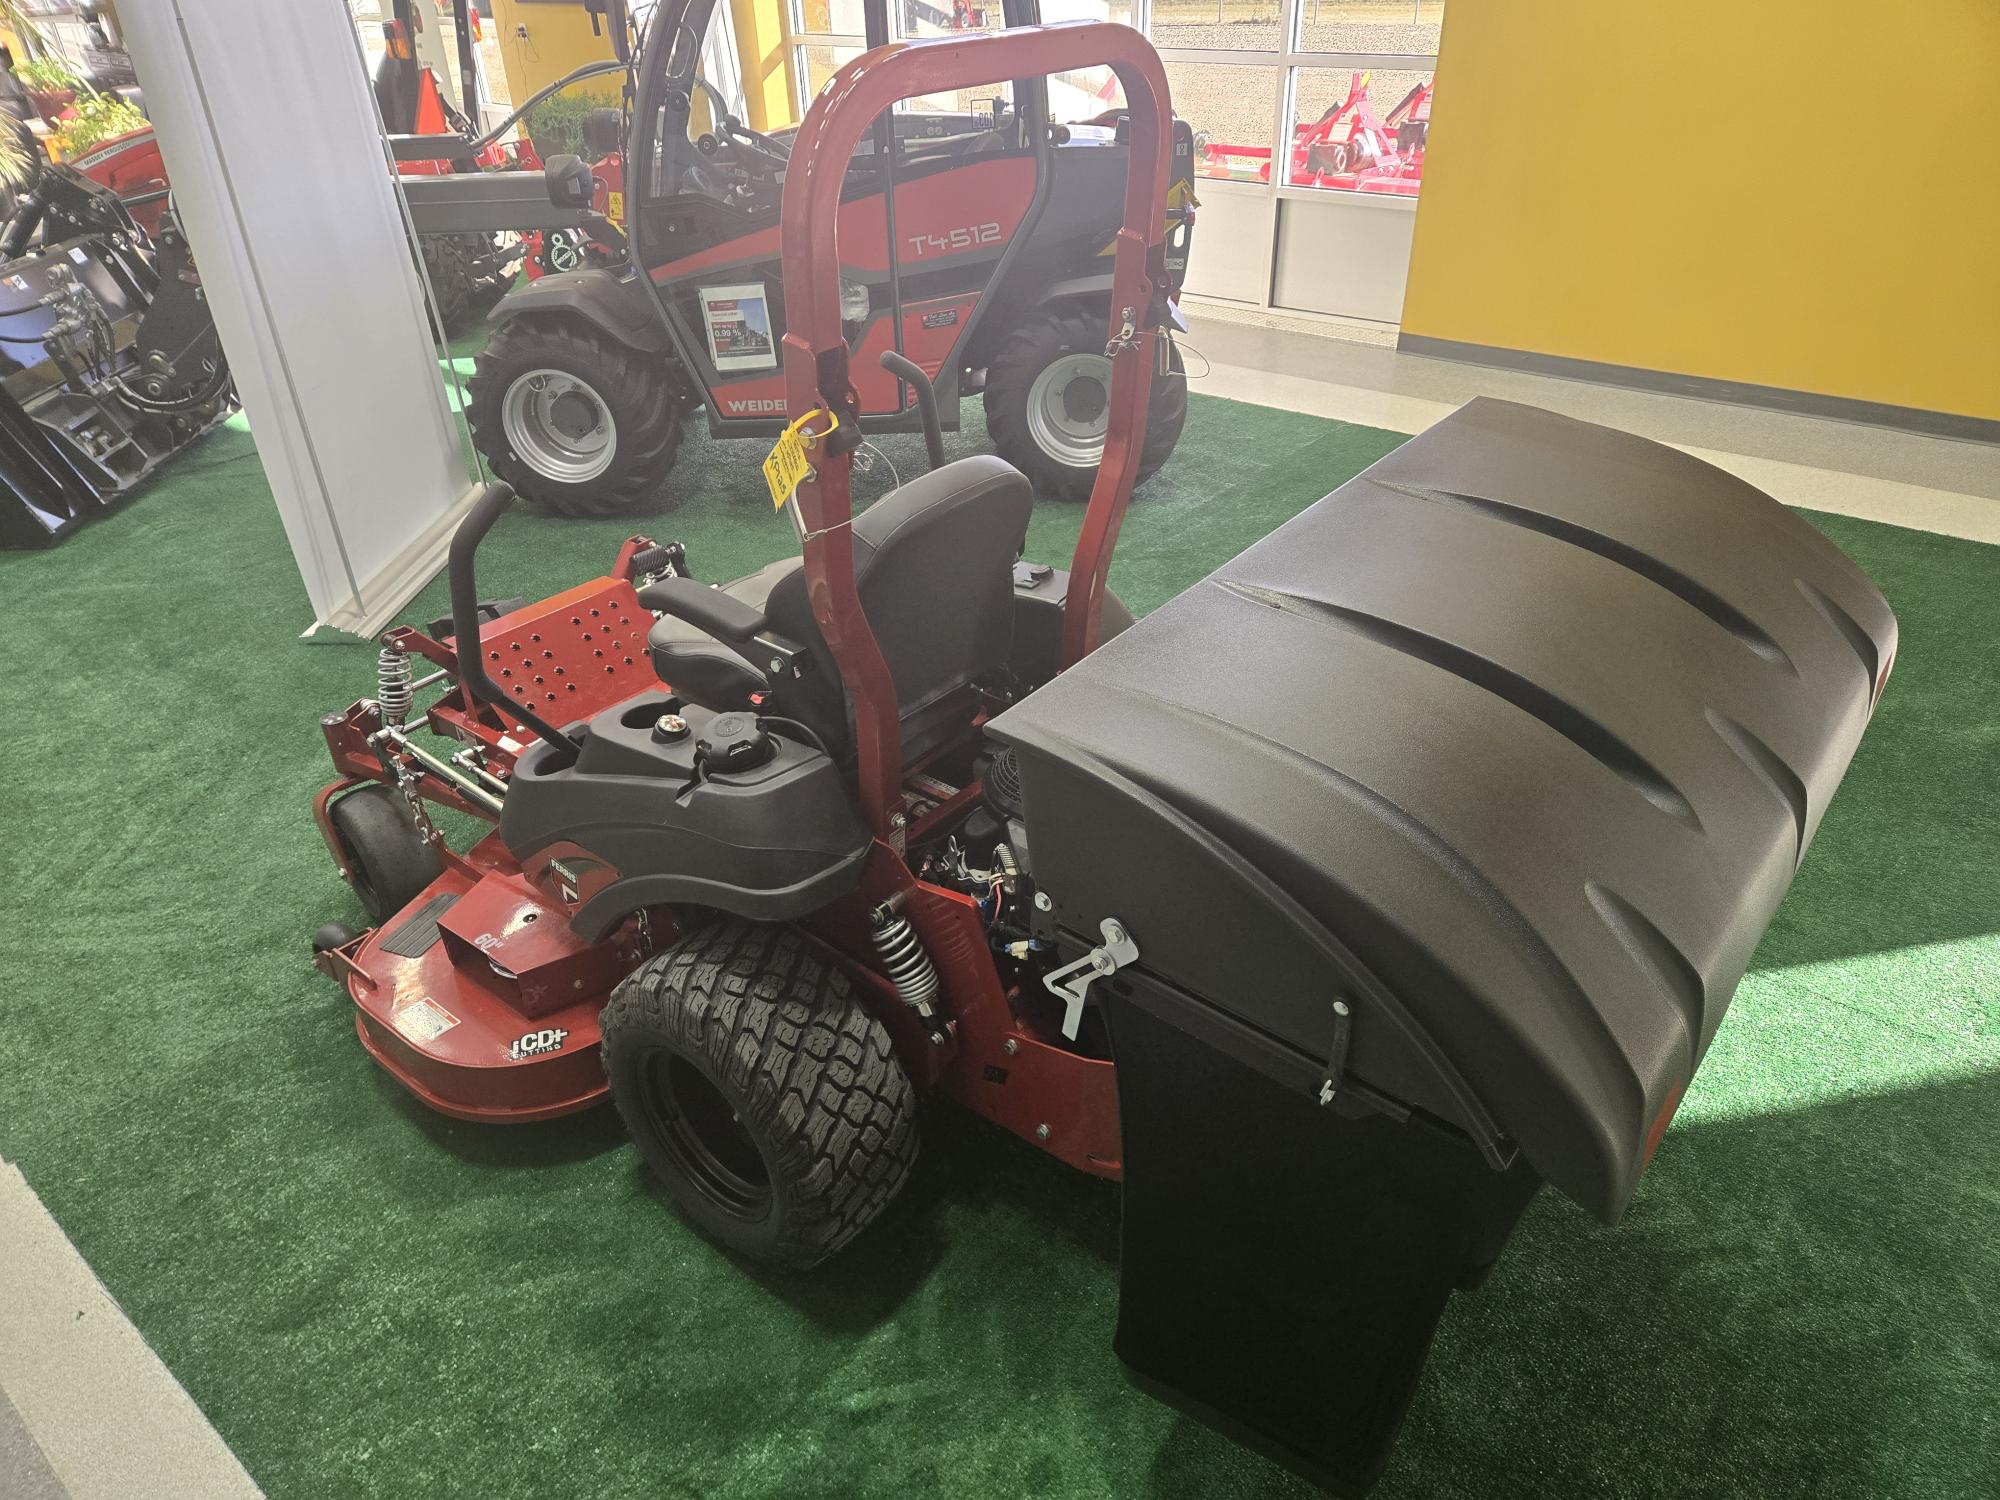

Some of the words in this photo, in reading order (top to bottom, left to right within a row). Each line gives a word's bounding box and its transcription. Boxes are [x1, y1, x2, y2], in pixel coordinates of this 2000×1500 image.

[909, 222, 1001, 255] T4512
[714, 329, 731, 337] 0.99
[728, 400, 787, 412] WEIDE
[551, 859, 577, 884] FERRIS
[512, 1043, 561, 1060] CUTTING
